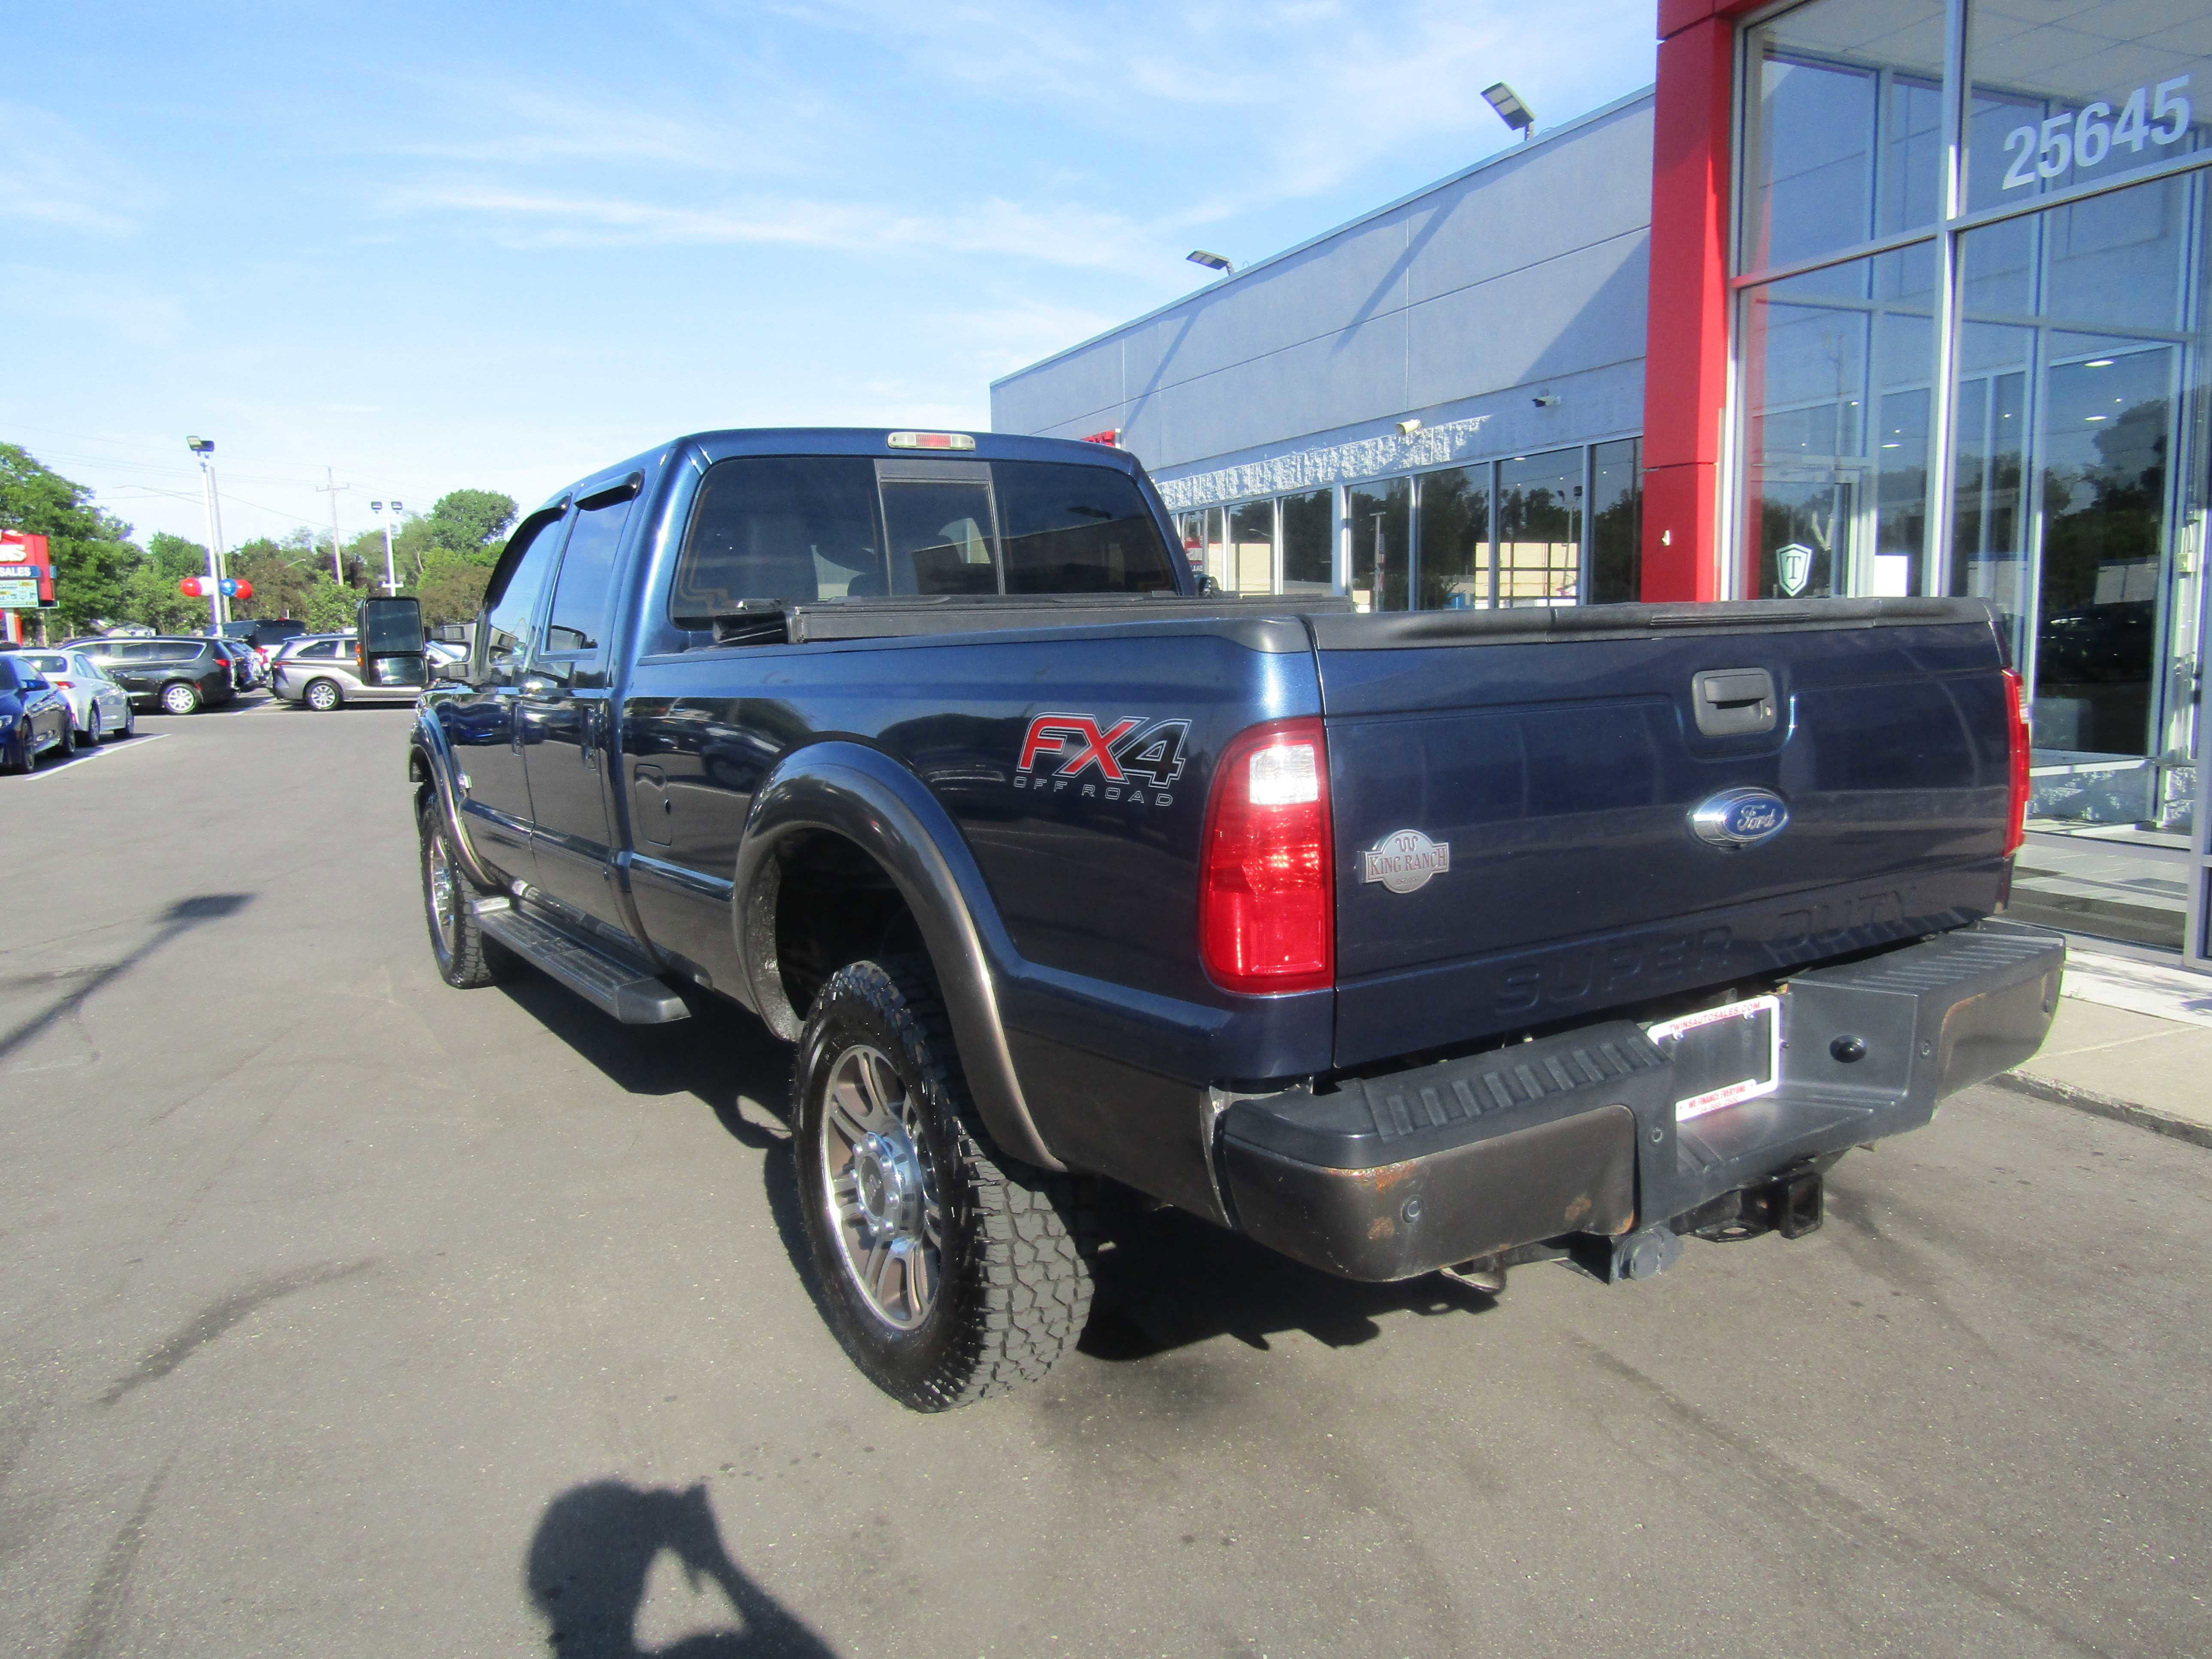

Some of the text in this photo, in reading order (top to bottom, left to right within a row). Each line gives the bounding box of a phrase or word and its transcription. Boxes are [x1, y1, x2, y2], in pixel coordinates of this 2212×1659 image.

[2002, 74, 2190, 191] 25645
[0, 566, 32, 577] SALES
[1016, 712, 1192, 789] FX4
[1013, 776, 1173, 806] OFF ROAD
[1737, 804, 1776, 832] Ford
[1370, 848, 1447, 876] KING RANCH
[1495, 924, 1733, 1012] SUPER
[1669, 1002, 1761, 1032] TWINSAUTOSALES.COM
